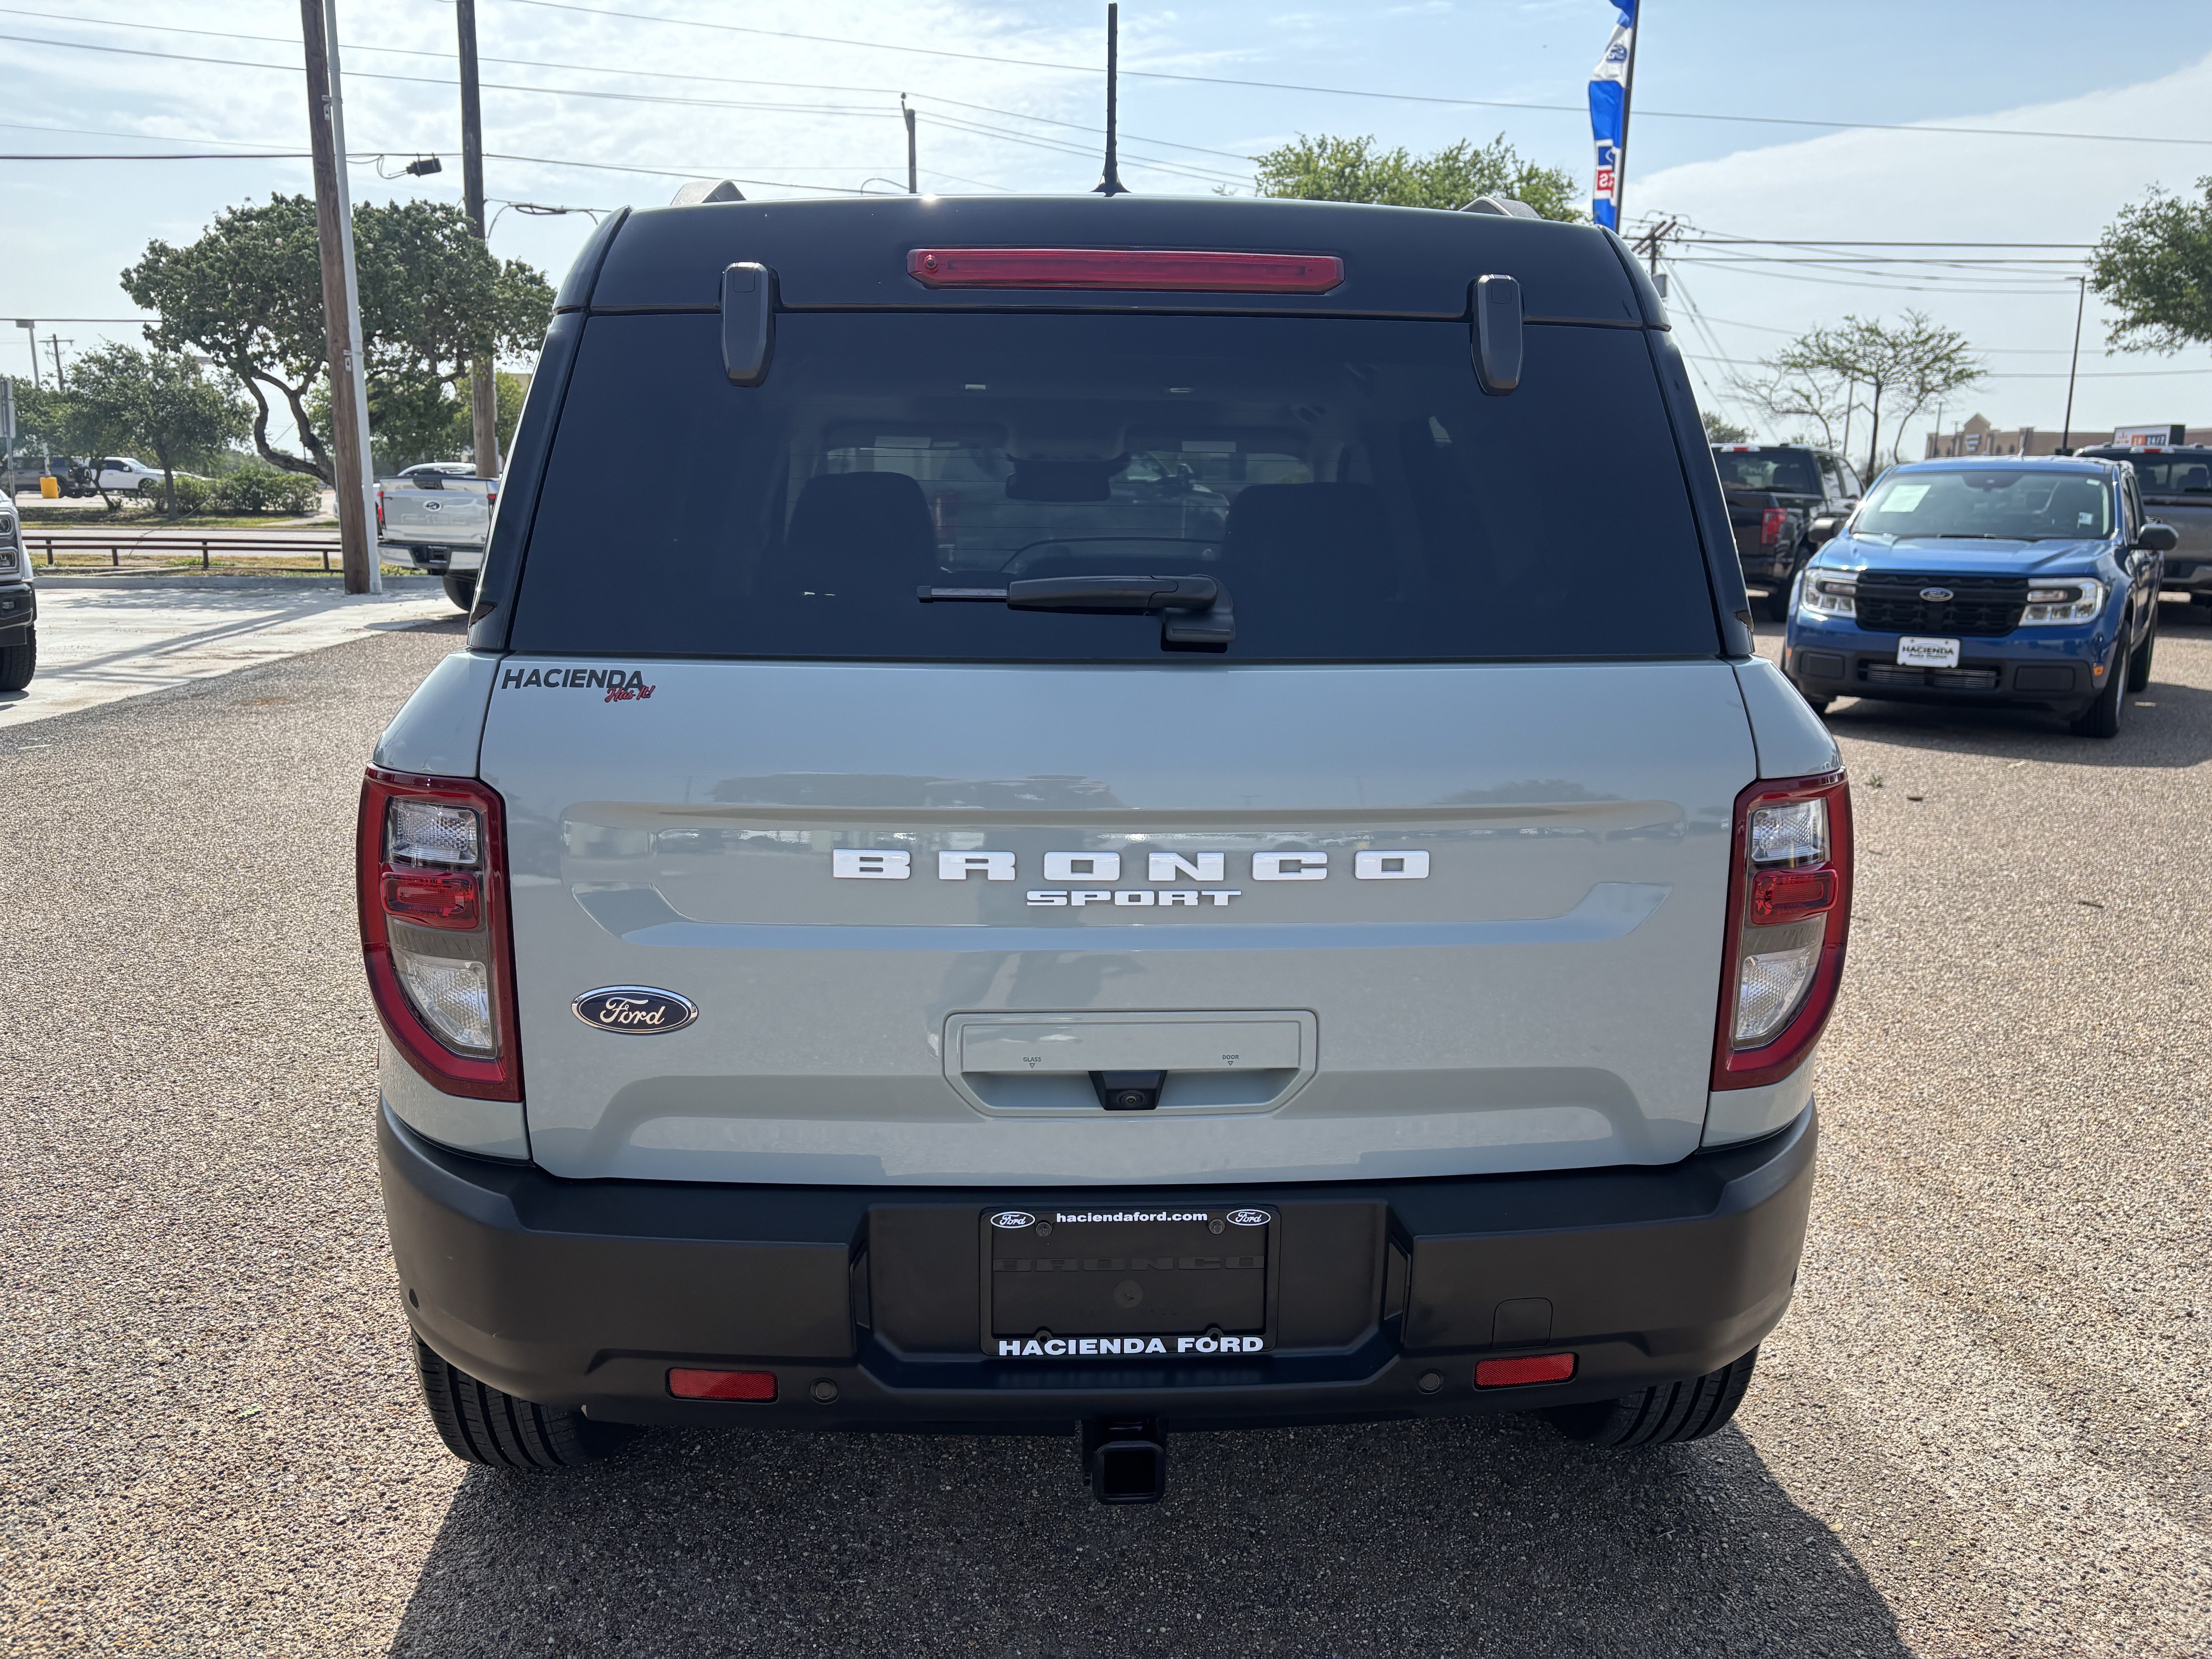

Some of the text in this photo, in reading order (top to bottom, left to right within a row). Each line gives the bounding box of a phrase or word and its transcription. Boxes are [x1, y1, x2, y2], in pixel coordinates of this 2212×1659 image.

[1902, 644, 1953, 654] HACIENDA
[501, 668, 645, 691] HACIENDA
[605, 687, 636, 703] Has
[833, 849, 1430, 881] BRONCO
[1027, 890, 1242, 906] SPORT
[599, 997, 666, 1025] Ford
[999, 1214, 1026, 1226] Ford
[1056, 1211, 1208, 1223] haciendaford.com
[1235, 1211, 1262, 1223] Ford
[993, 1256, 1264, 1272] BRONCO
[999, 1336, 1264, 1356] HACIENDA FORD
